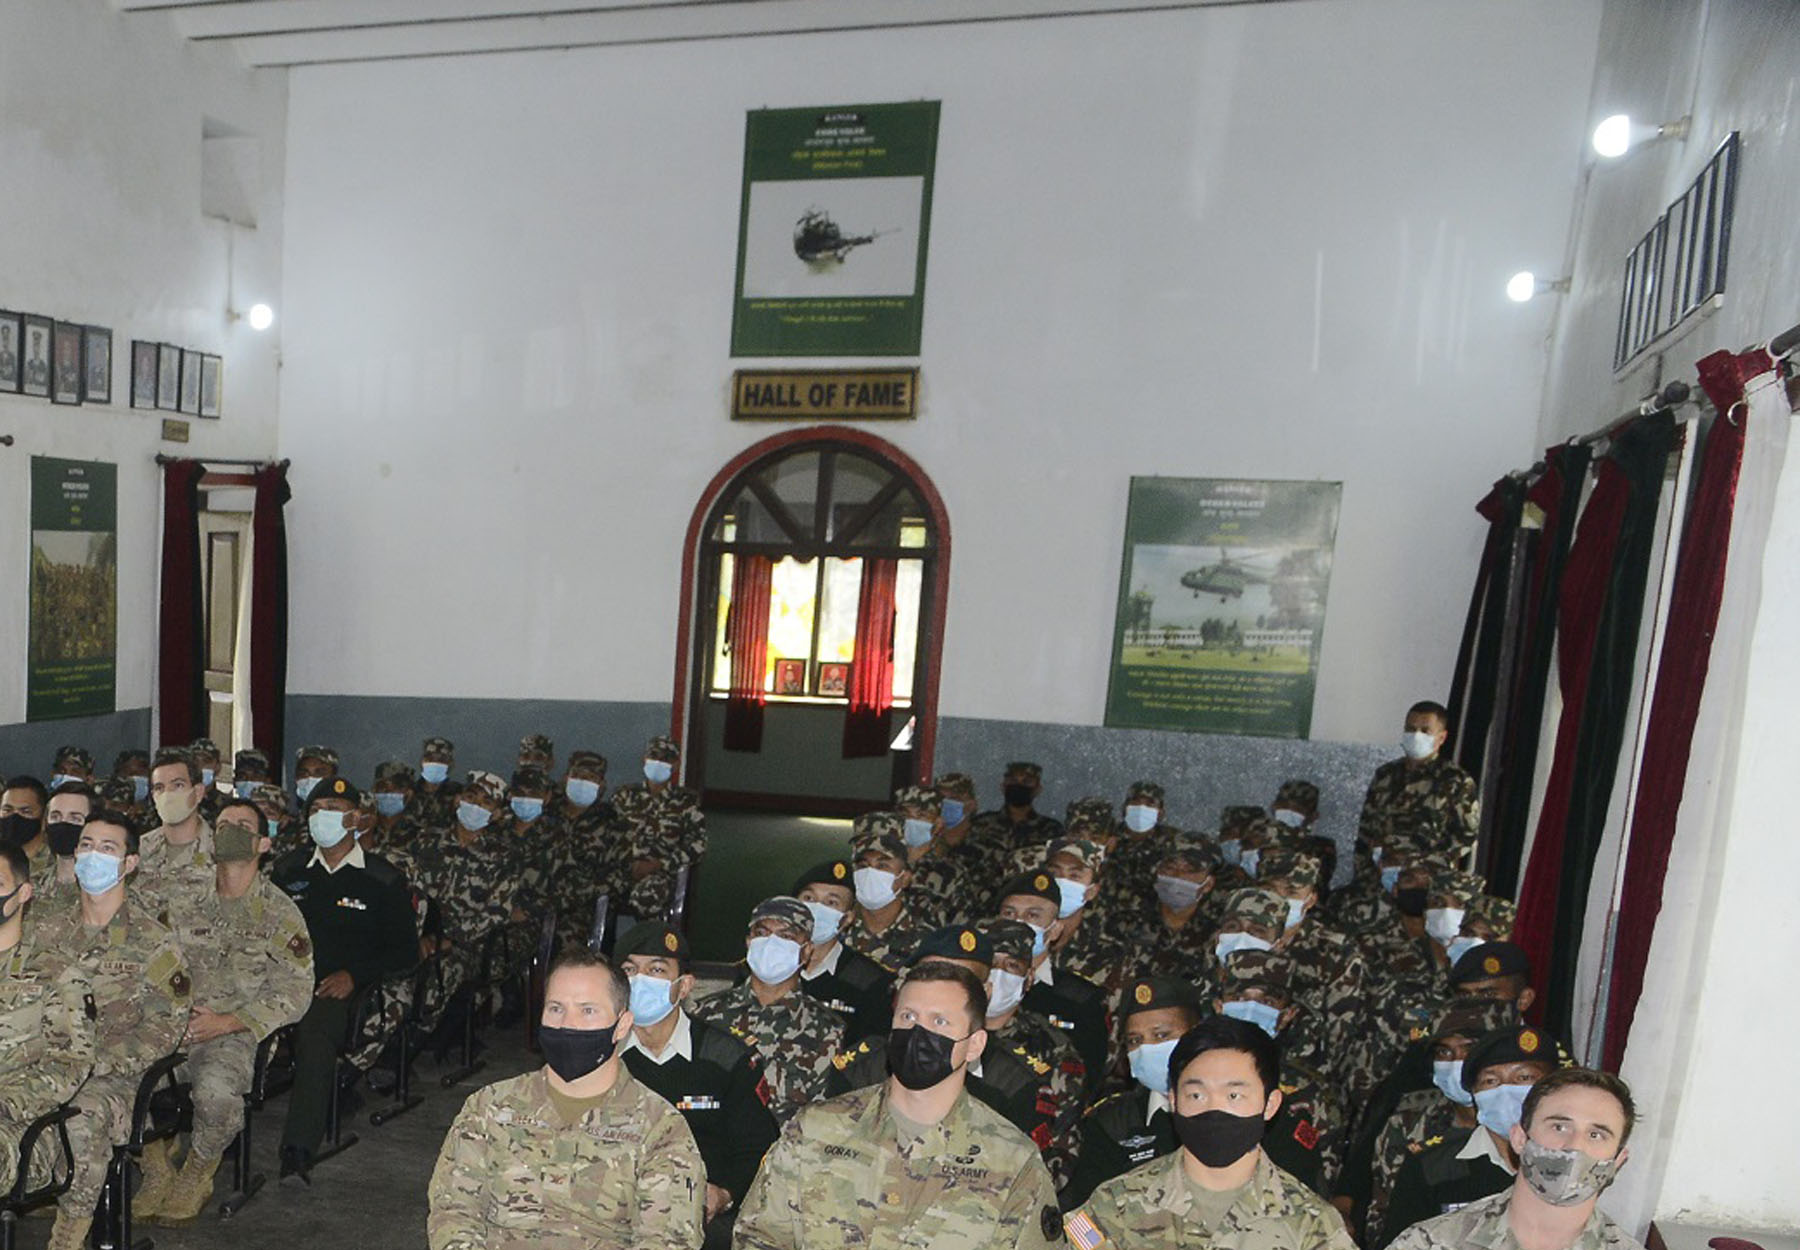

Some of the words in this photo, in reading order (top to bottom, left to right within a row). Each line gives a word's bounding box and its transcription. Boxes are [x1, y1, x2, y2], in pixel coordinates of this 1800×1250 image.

[744, 384, 801, 407] HALL
[808, 383, 837, 407] OF
[844, 383, 906, 407] FAME
[824, 1144, 860, 1159] GORAY
